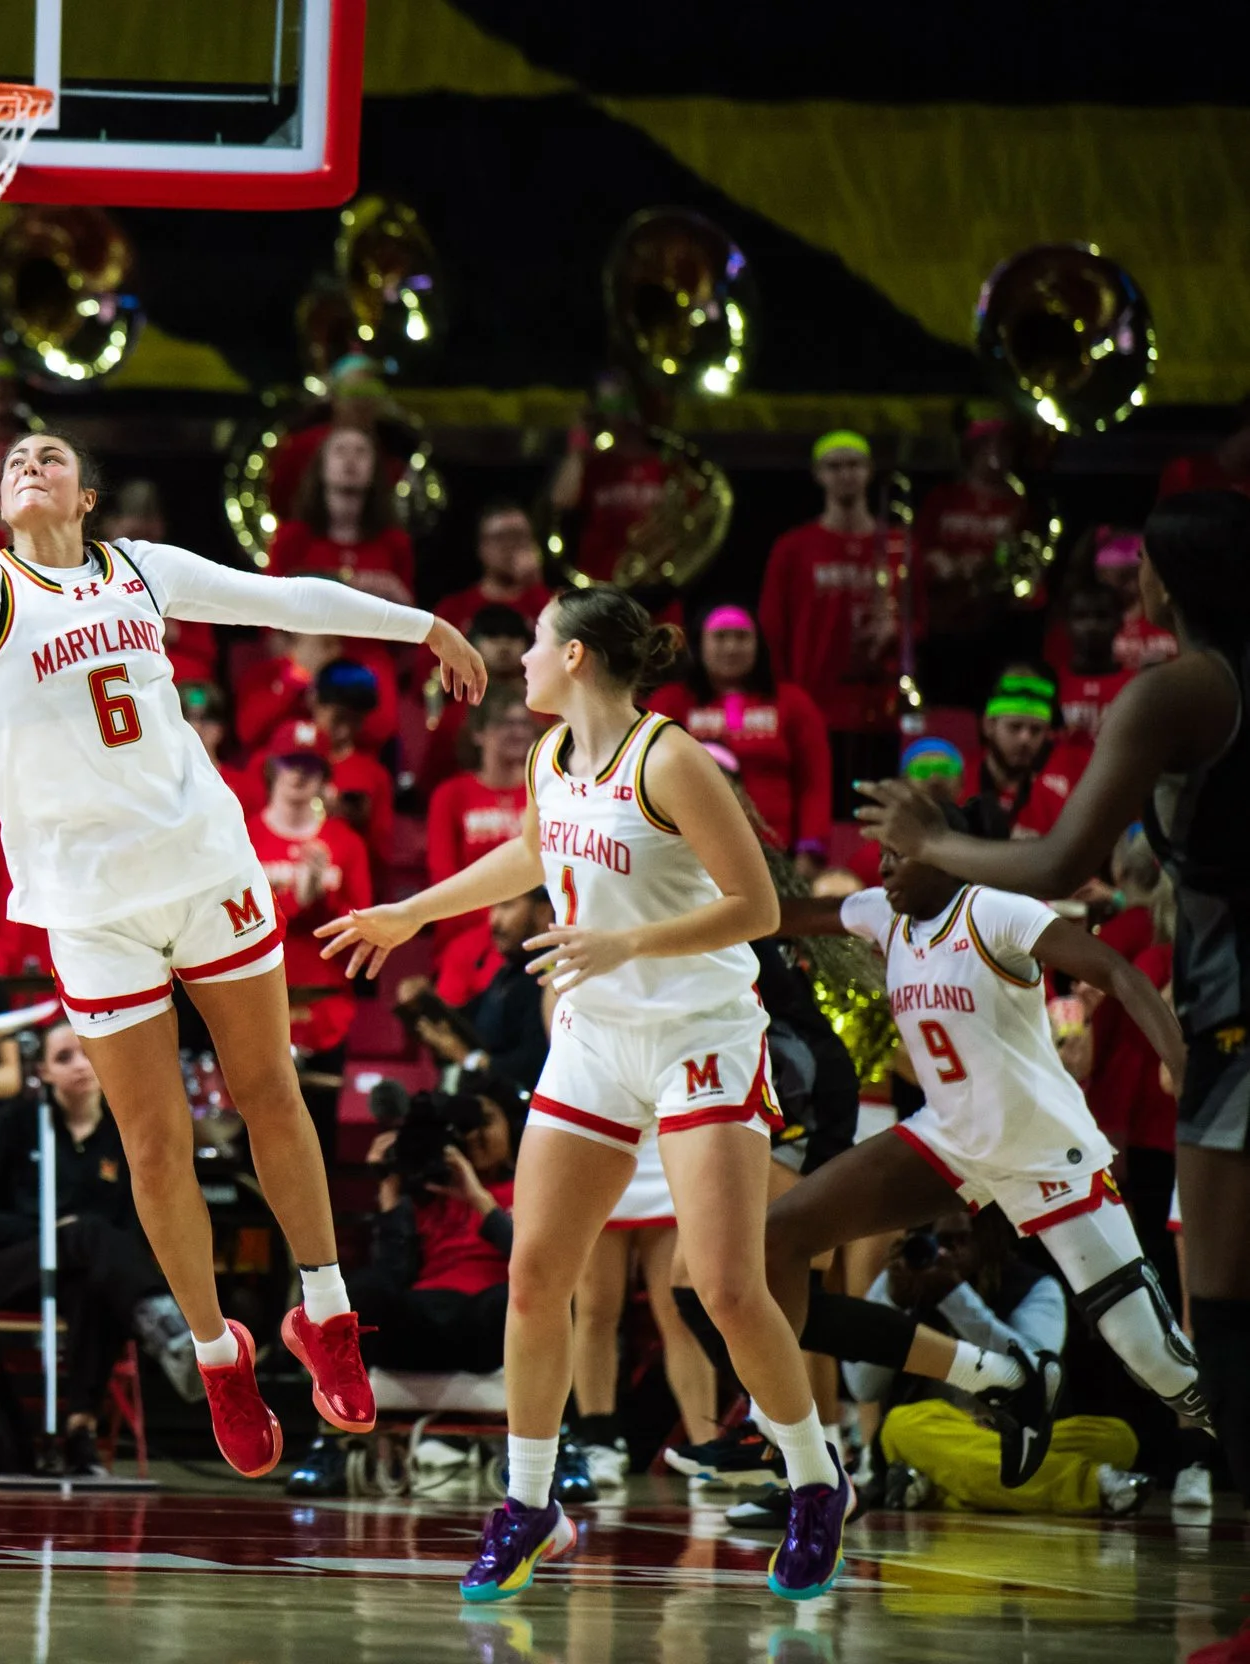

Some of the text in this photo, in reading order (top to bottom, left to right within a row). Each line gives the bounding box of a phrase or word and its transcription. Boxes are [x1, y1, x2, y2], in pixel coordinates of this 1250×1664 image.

[31, 619, 161, 683] MARYLAND
[88, 663, 142, 748] 6
[540, 820, 630, 875] ARYLAND
[220, 886, 264, 933] M
[562, 865, 578, 926] 1
[681, 1053, 723, 1095] M
[918, 1019, 967, 1084] 9
